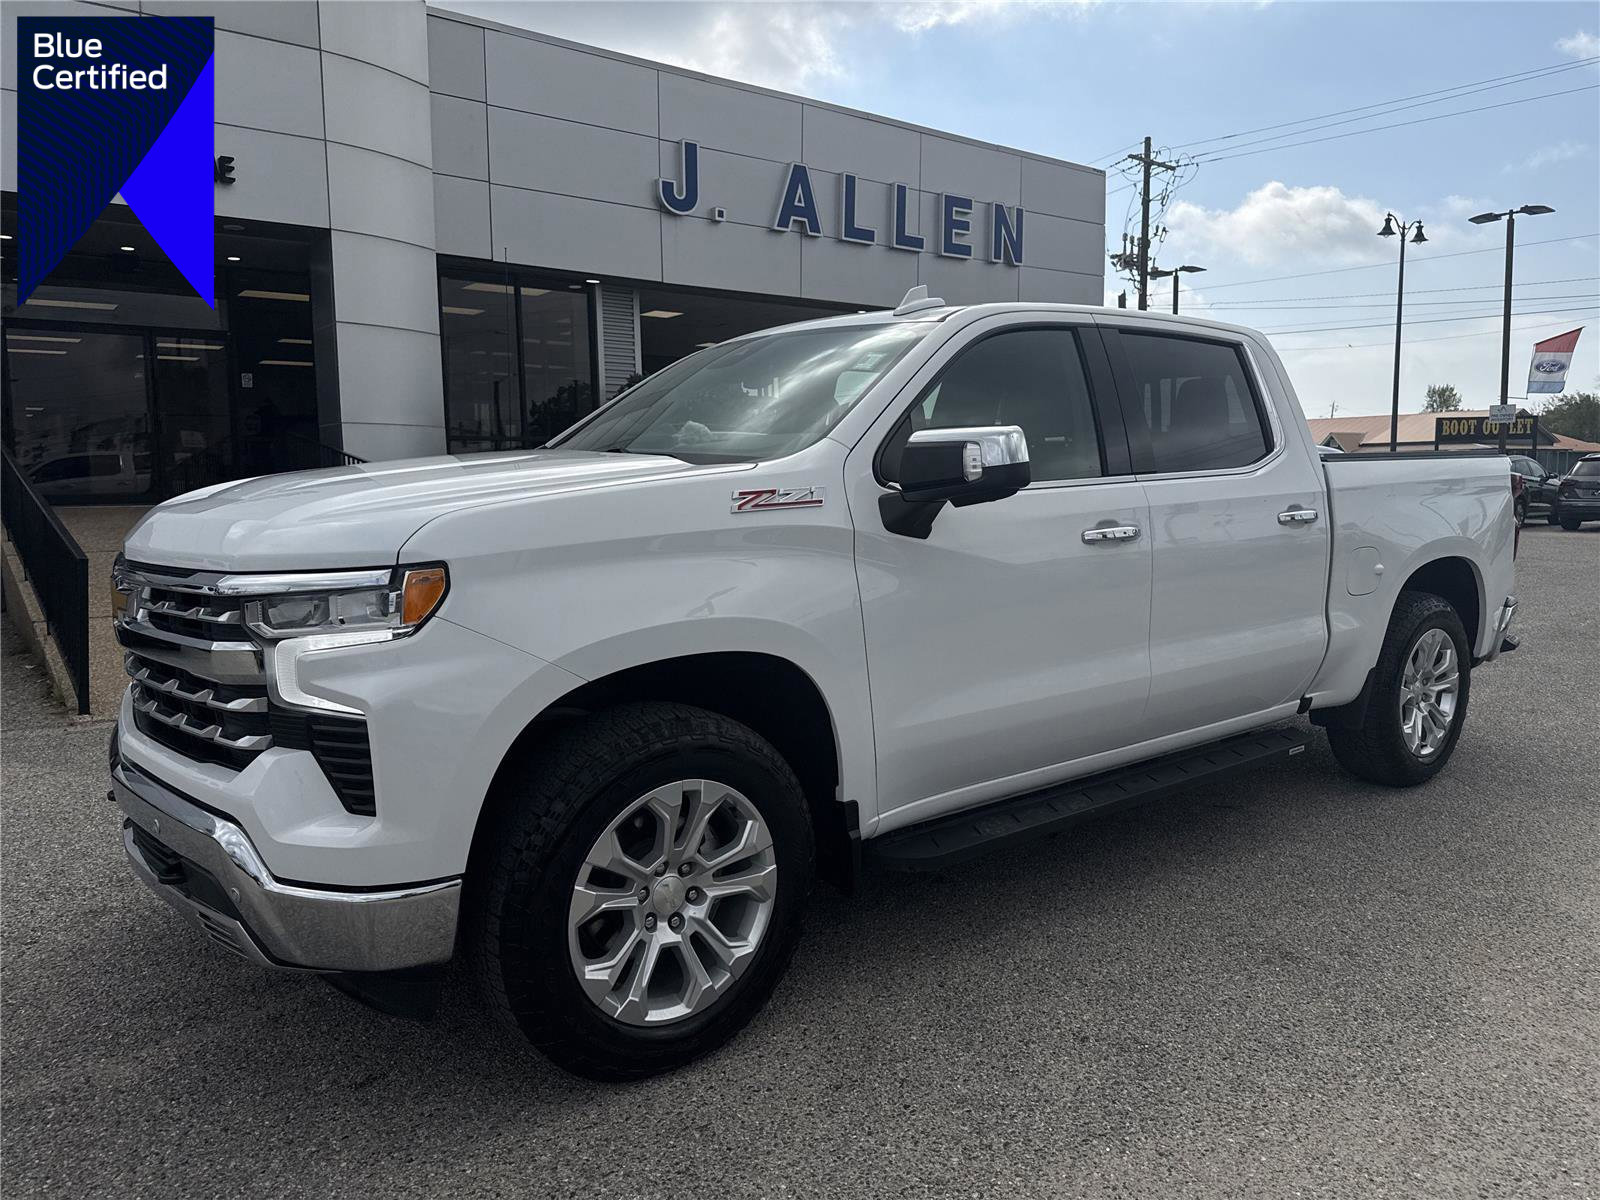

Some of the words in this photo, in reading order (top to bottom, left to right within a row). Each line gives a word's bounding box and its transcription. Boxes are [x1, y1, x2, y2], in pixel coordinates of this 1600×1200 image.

[657, 138, 727, 222] J.
[772, 161, 1025, 267] ALLEN
[1539, 361, 1561, 372] Ford
[1442, 419, 1477, 435] BOOT
[1482, 418, 1534, 435] OULET
[731, 486, 826, 514] Z71
